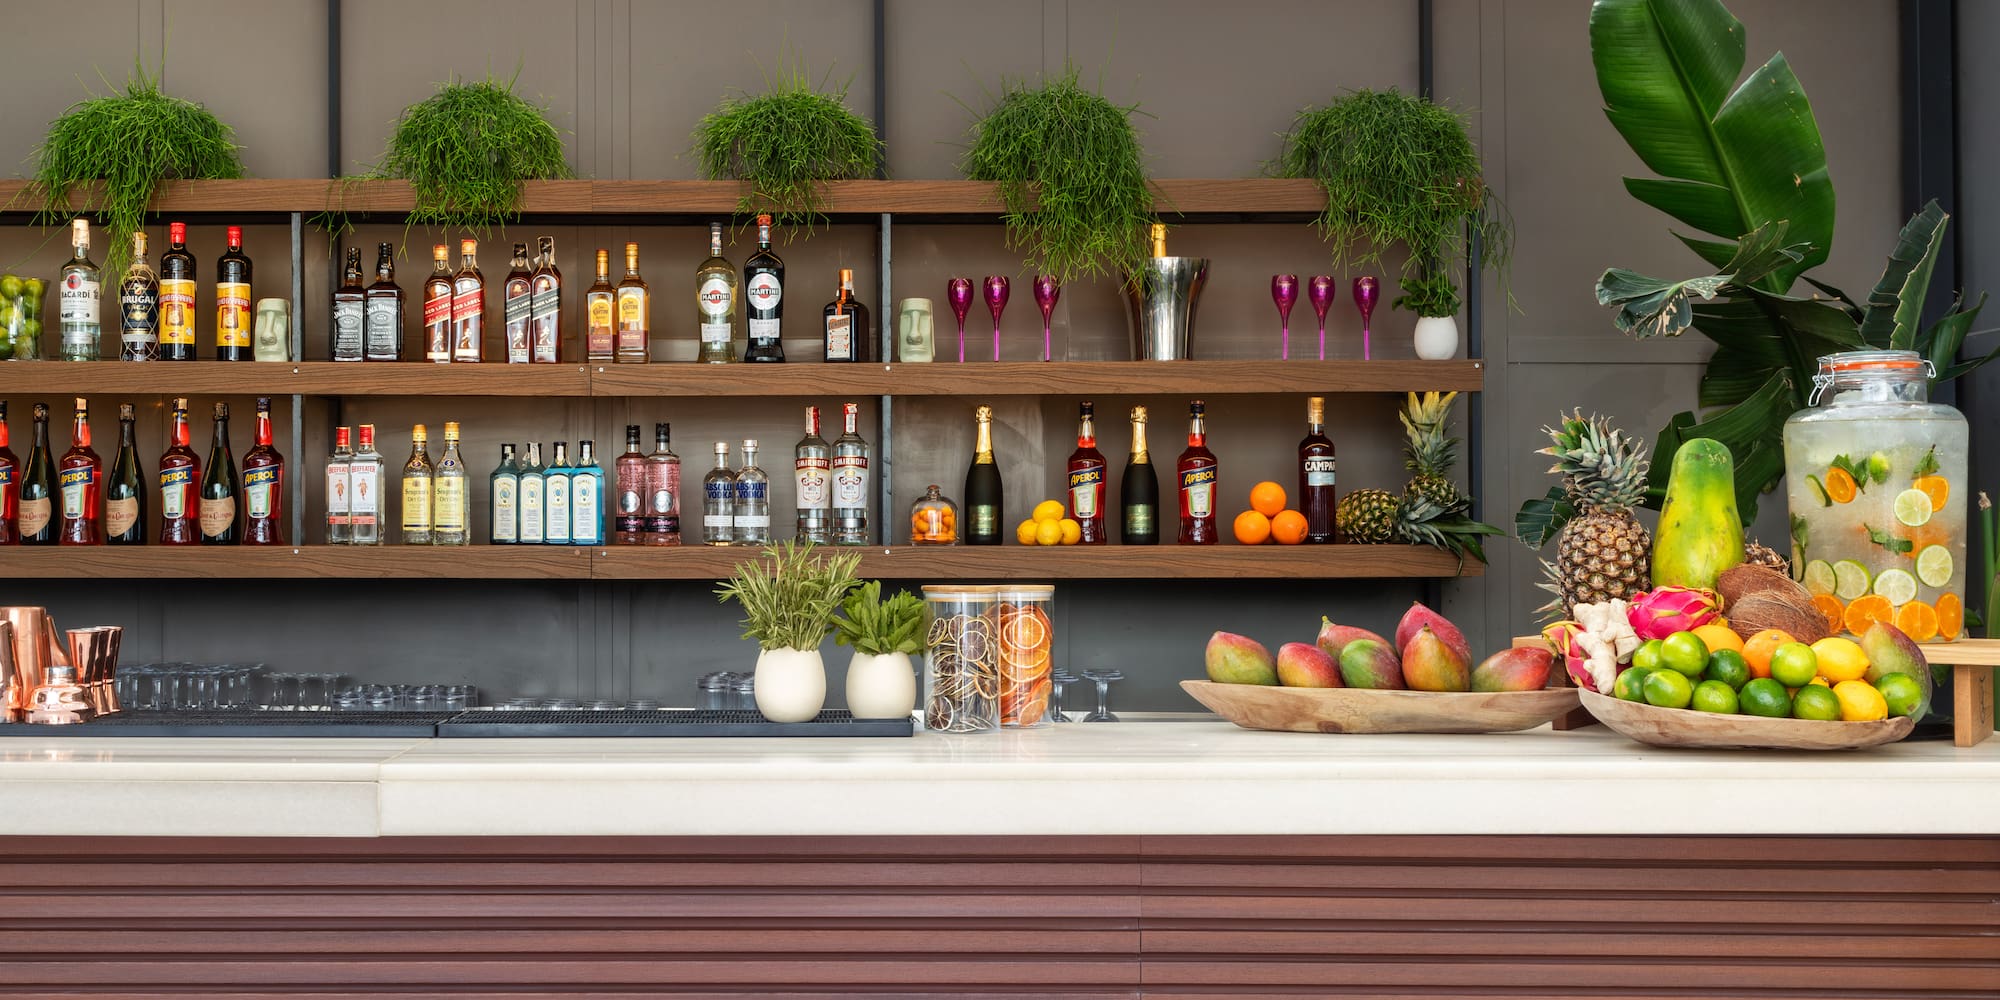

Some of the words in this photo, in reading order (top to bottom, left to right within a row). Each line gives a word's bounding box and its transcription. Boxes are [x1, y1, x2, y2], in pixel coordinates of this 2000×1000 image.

[750, 288, 779, 296] MARTINI
[122, 295, 155, 304] BRUGAL
[702, 293, 731, 301] MARTINI
[351, 465, 376, 473] BEEFEATER
[61, 472, 89, 485] APEROL
[160, 471, 188, 485] APEROL
[245, 471, 275, 486] APEROL
[1071, 471, 1100, 486] APEROL
[1184, 470, 1215, 486] APEROL
[708, 490, 733, 499] VODKA
[738, 490, 764, 499] VODKA
